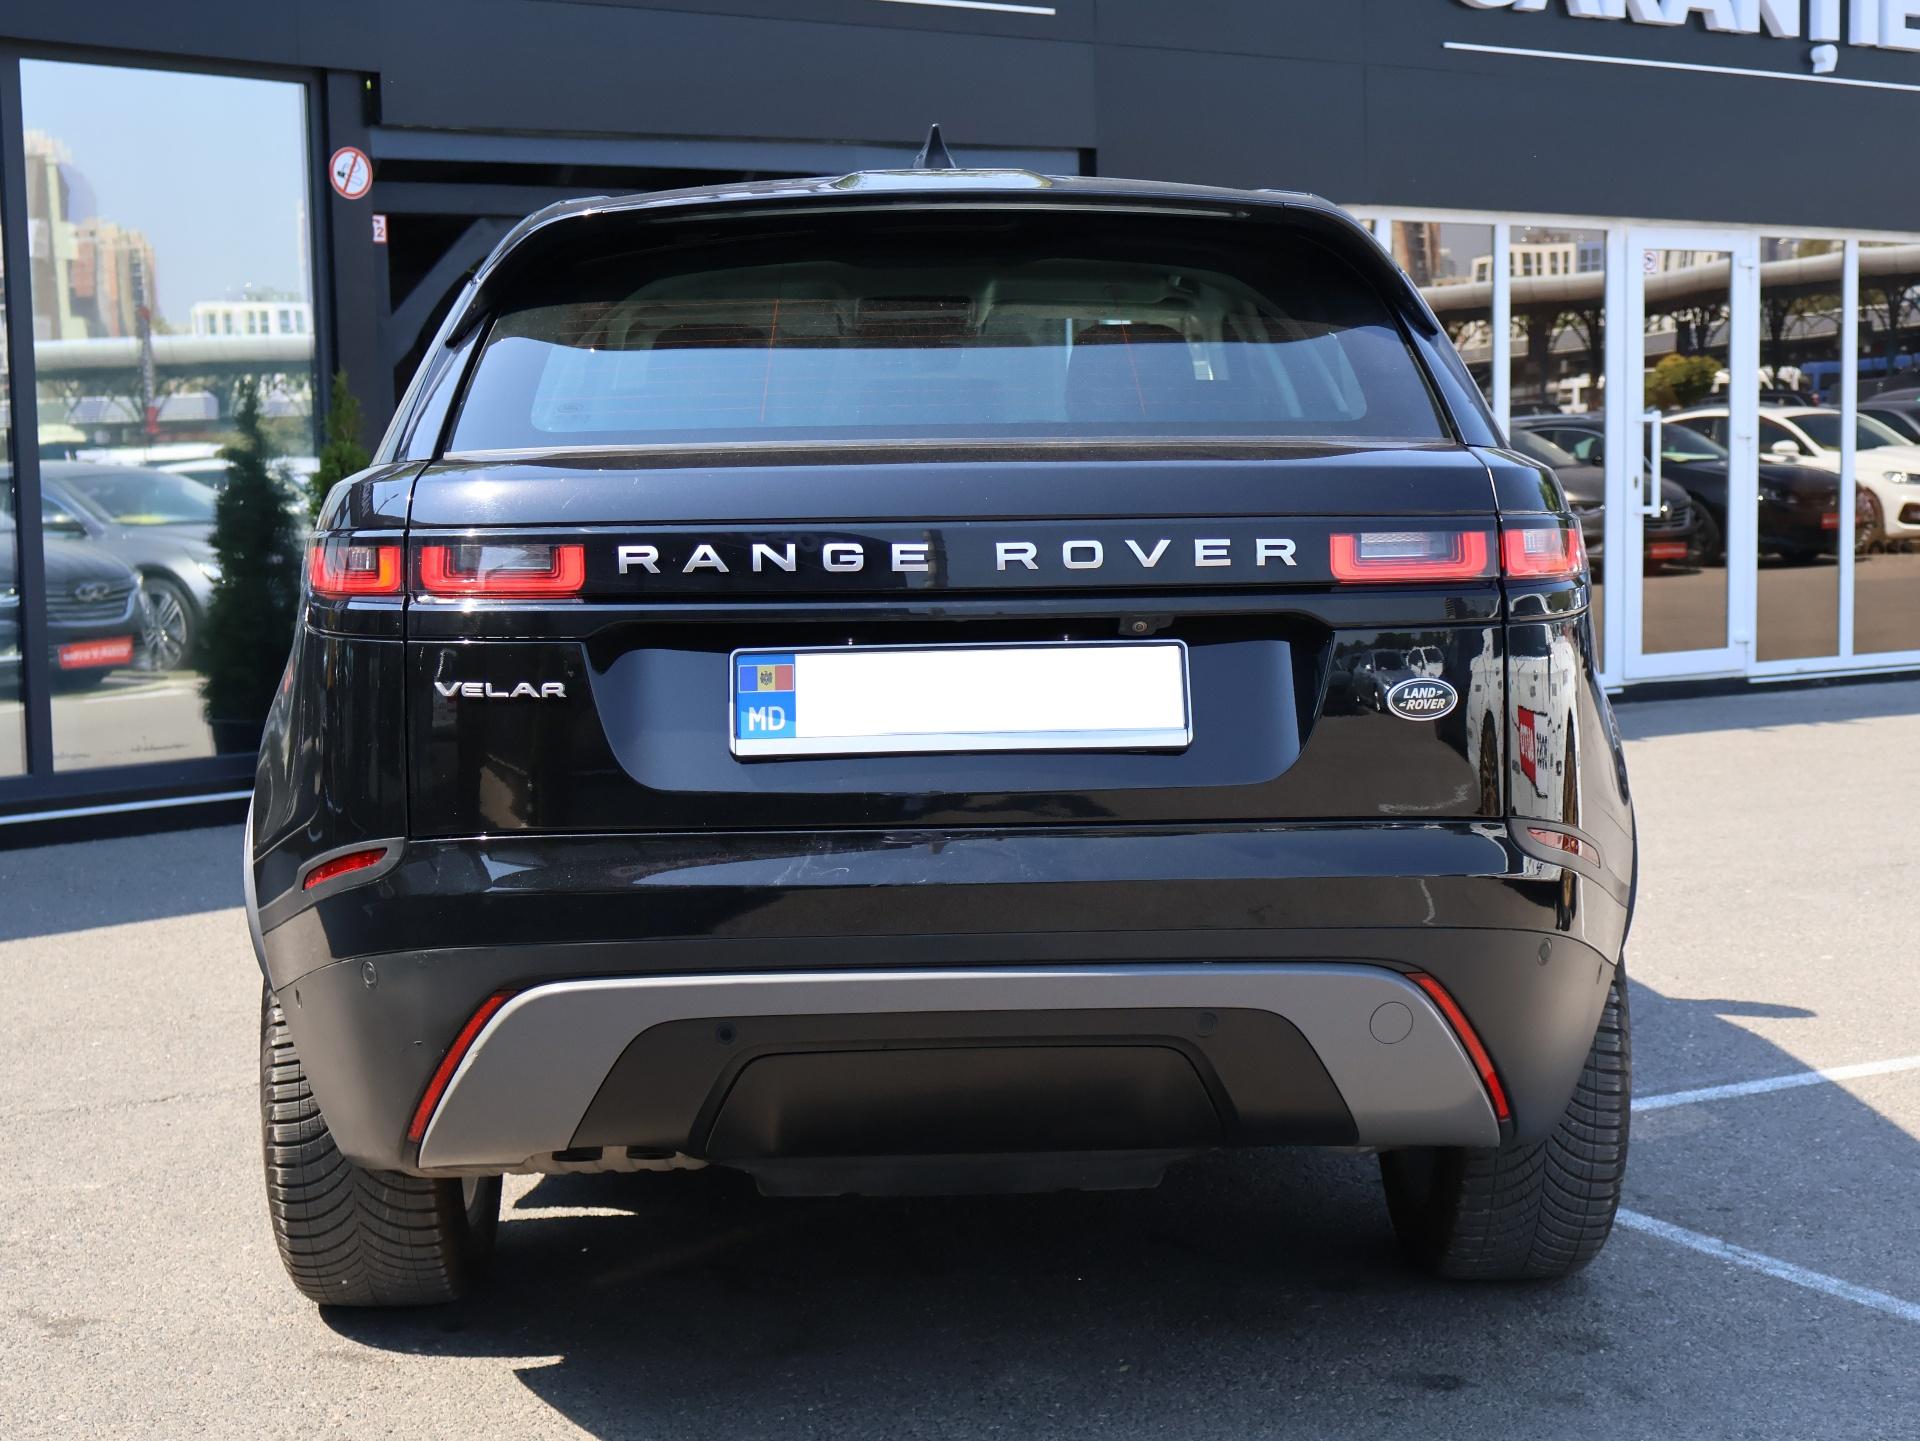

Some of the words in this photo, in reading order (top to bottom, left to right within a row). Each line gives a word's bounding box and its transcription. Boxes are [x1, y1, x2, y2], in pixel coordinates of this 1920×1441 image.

[617, 543, 929, 574] RANGE
[995, 538, 1298, 571] ROVER
[434, 681, 567, 698] VELAR
[1403, 687, 1436, 699] LAND
[1405, 698, 1446, 710] ROVER
[748, 706, 786, 731] MD
